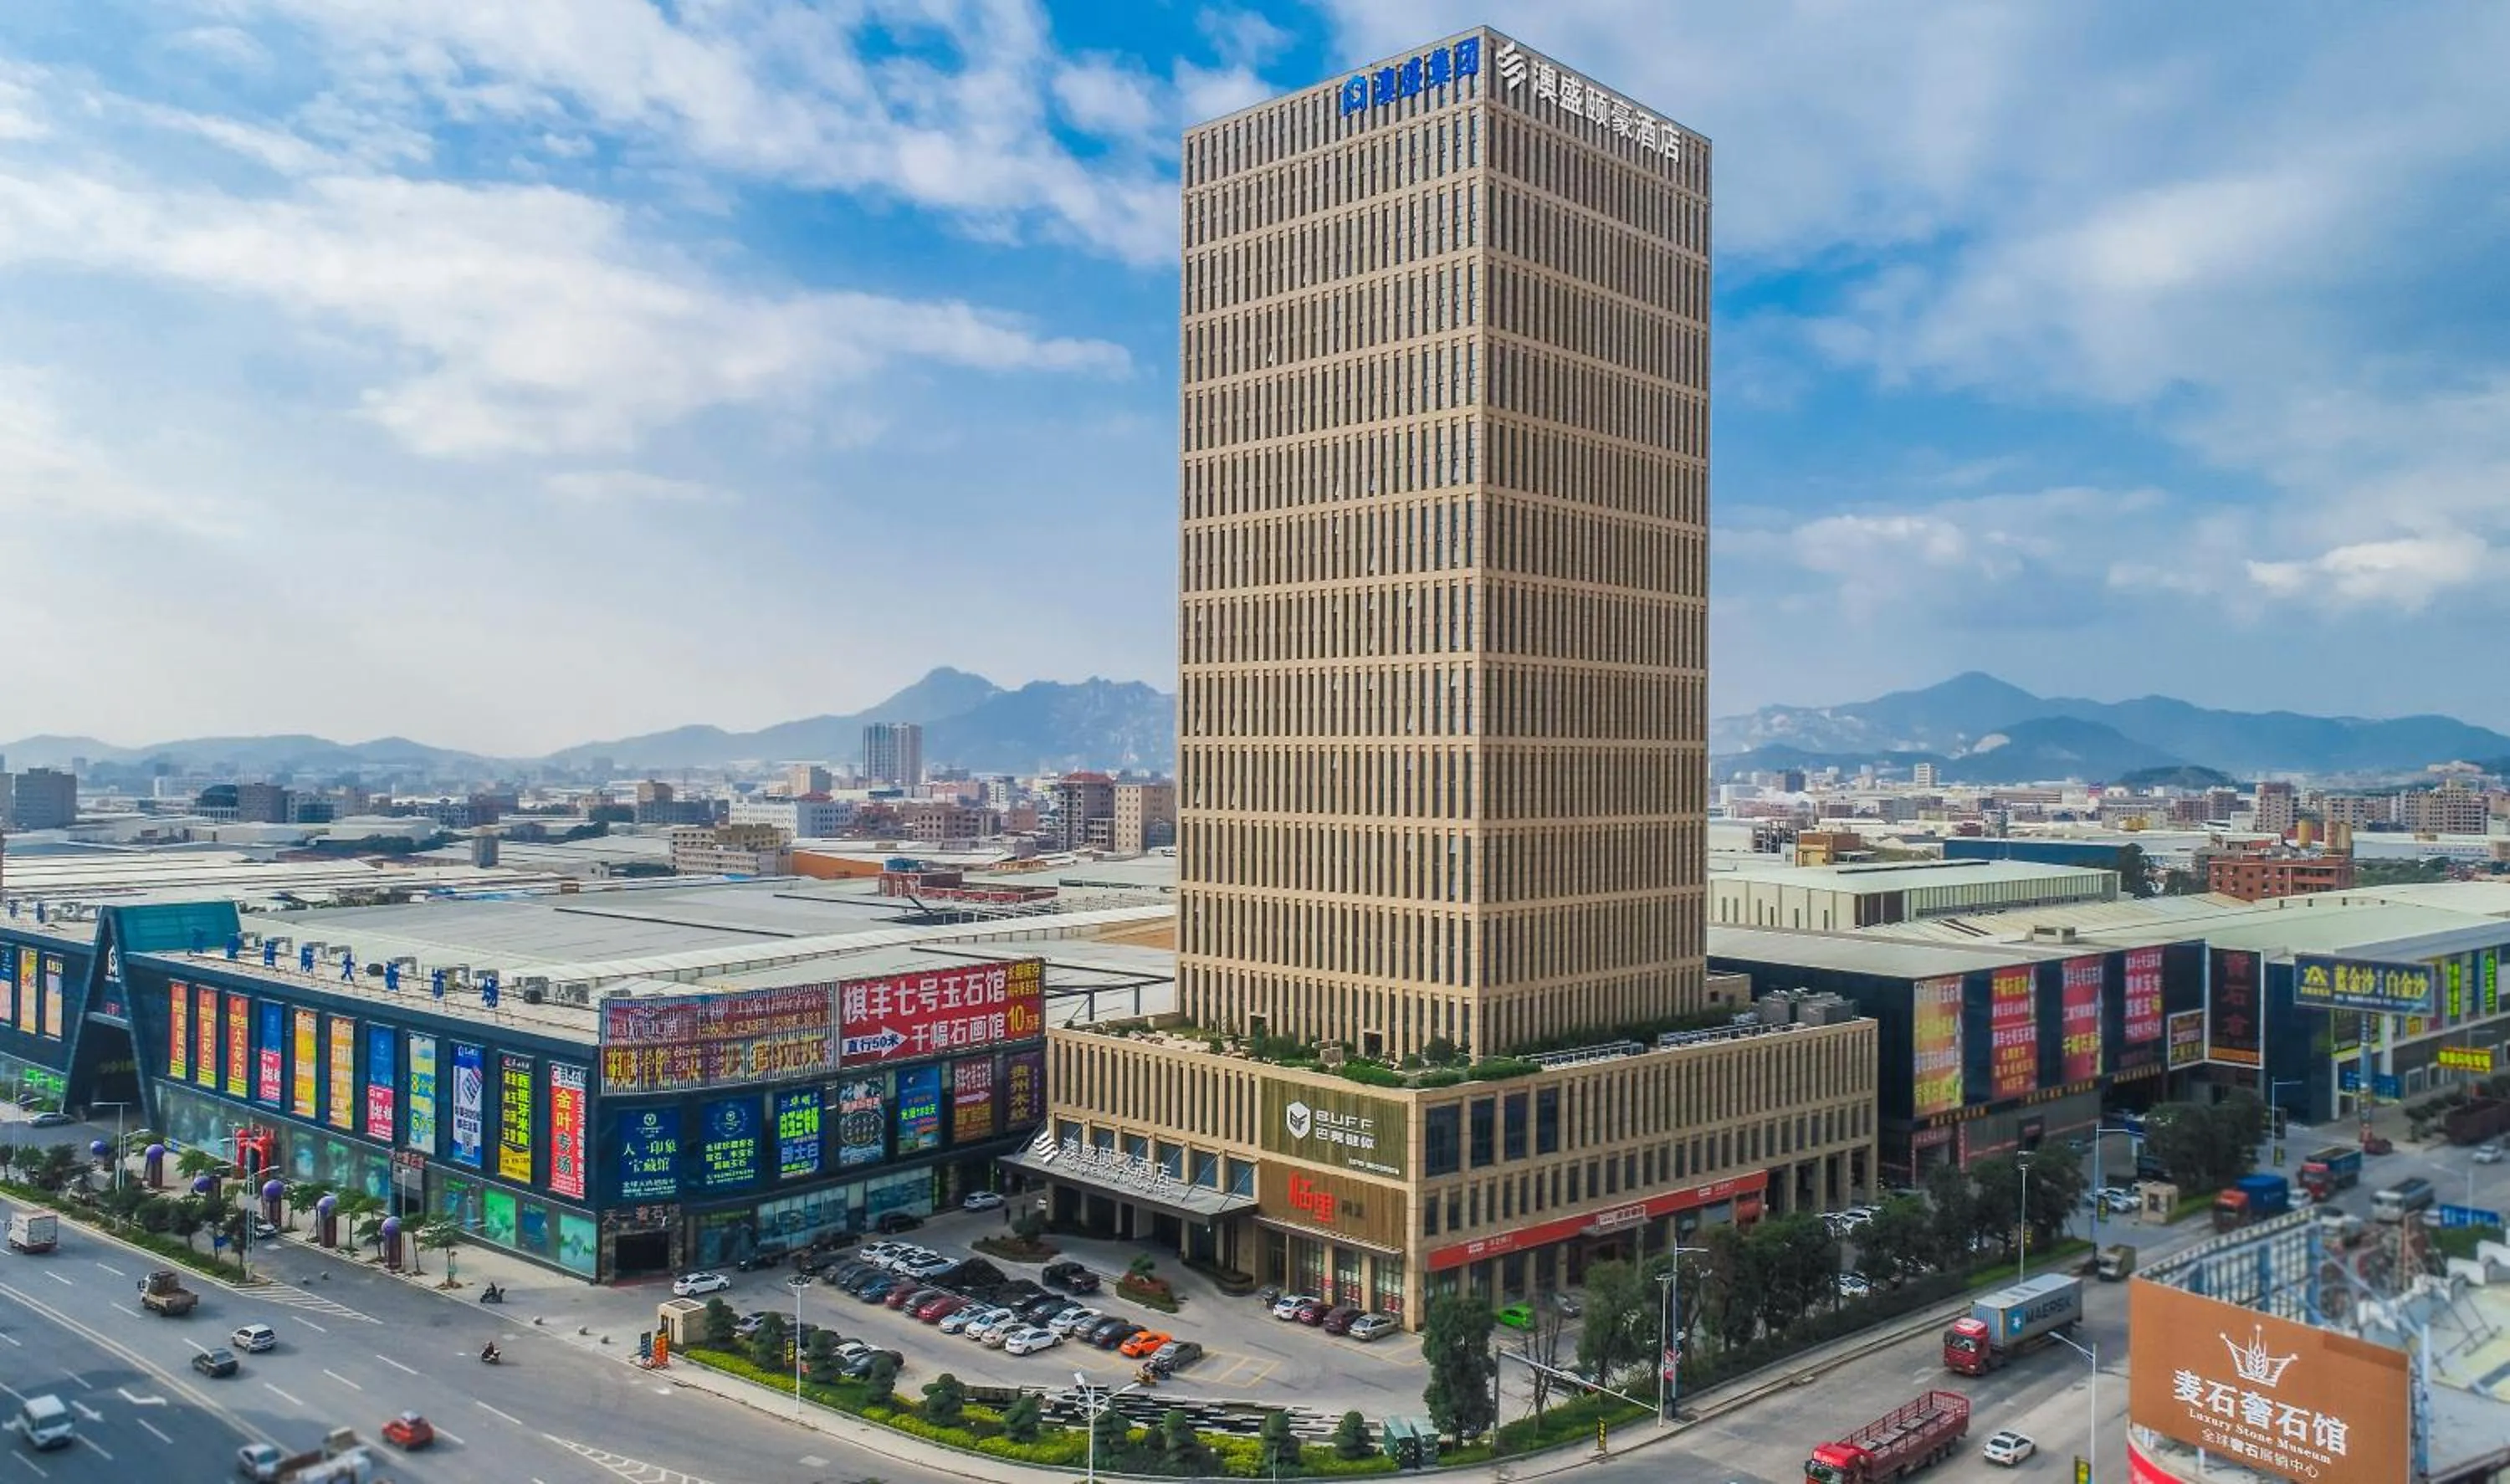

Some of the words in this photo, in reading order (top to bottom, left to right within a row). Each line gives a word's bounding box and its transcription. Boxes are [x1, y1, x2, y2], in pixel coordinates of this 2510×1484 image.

[1372, 36, 1480, 106] 澳盛集团
[1532, 60, 1682, 164] 澳盛颐豪酒店
[847, 1033, 900, 1053] 直行50米
[1316, 1110, 1375, 1129] BUFF
[2173, 1369, 2349, 1456] 麦石奢石馆
[2189, 1407, 2232, 1433] Luxury
[2236, 1422, 2274, 1446] Stone
[2277, 1436, 2333, 1465] Museum
